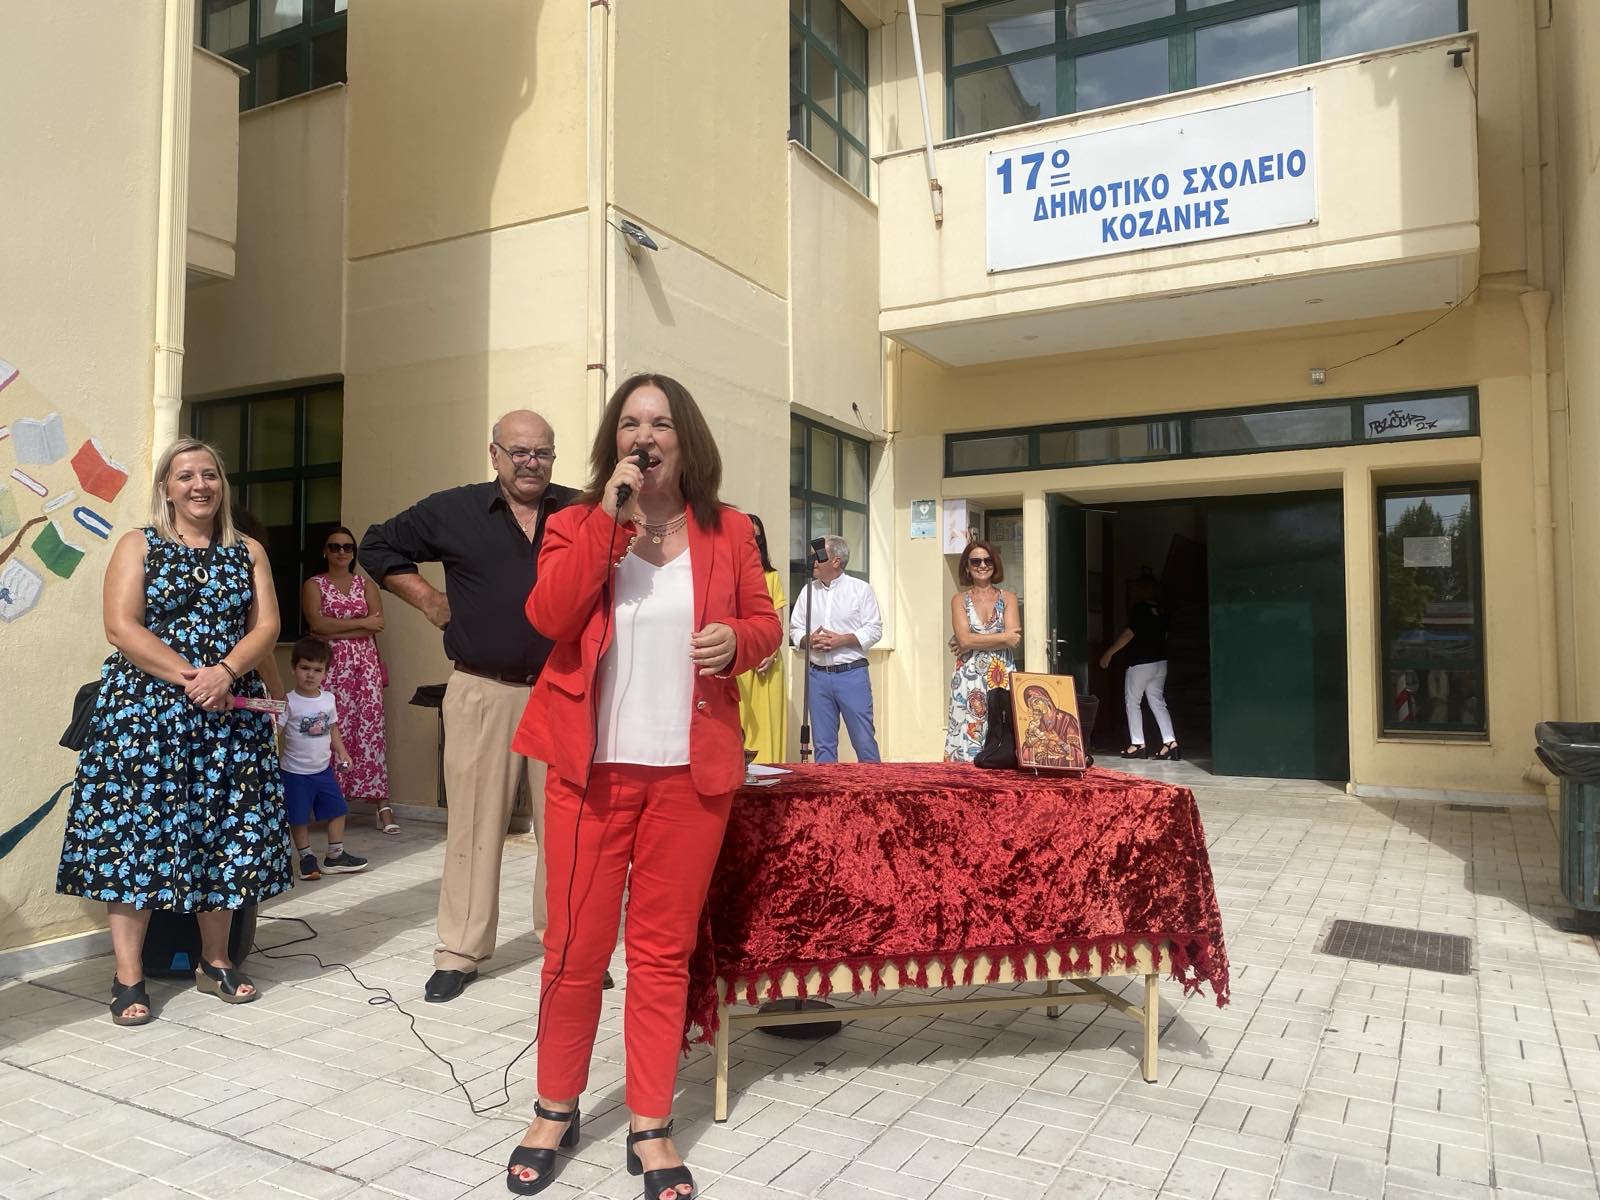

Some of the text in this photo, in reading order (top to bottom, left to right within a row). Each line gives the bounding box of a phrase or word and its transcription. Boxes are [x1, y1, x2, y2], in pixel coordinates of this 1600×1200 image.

[1033, 149, 1306, 222] ΔΗΜΟΤΙΚΟ ΣΧΟΛΕΙΟ
[1102, 198, 1230, 243] ΚΟΖΑΝΗΣ
